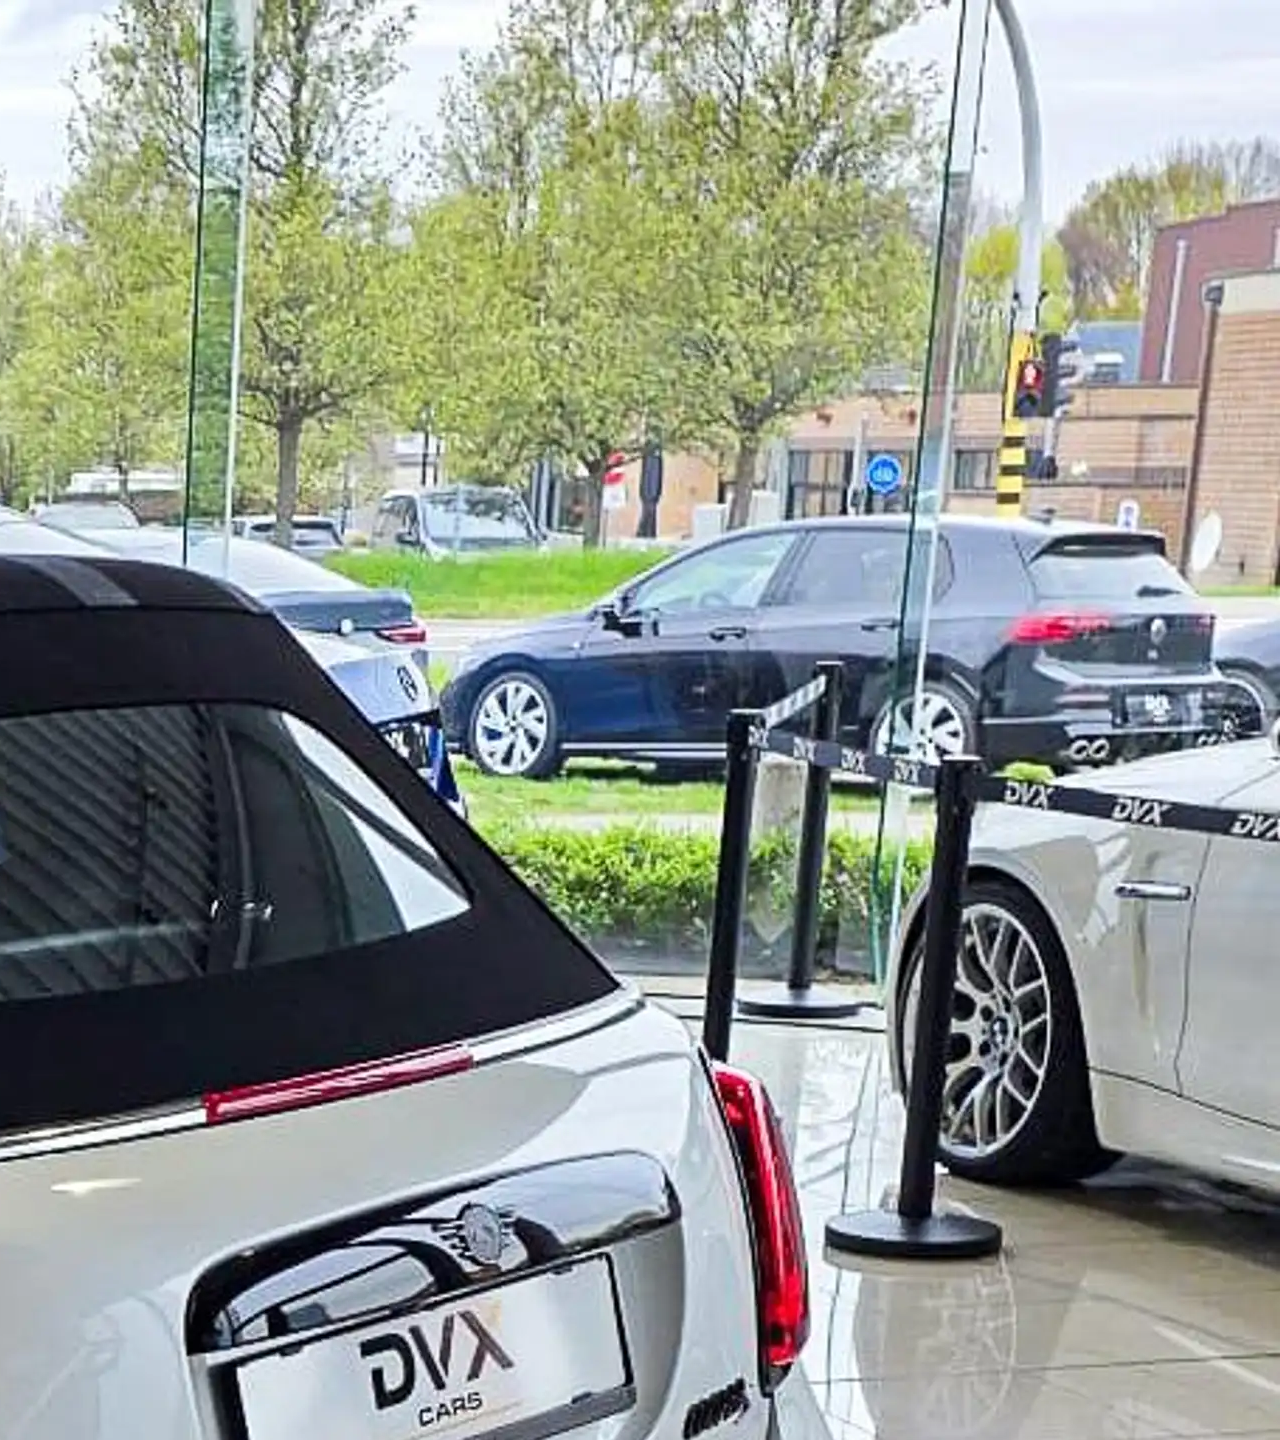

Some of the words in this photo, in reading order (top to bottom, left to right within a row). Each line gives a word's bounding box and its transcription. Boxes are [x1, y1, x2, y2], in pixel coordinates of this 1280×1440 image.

[1004, 780, 1055, 811] DVX
[1111, 798, 1173, 826] DVX
[360, 1310, 514, 1410] DVX
[418, 1391, 483, 1427] CARS
